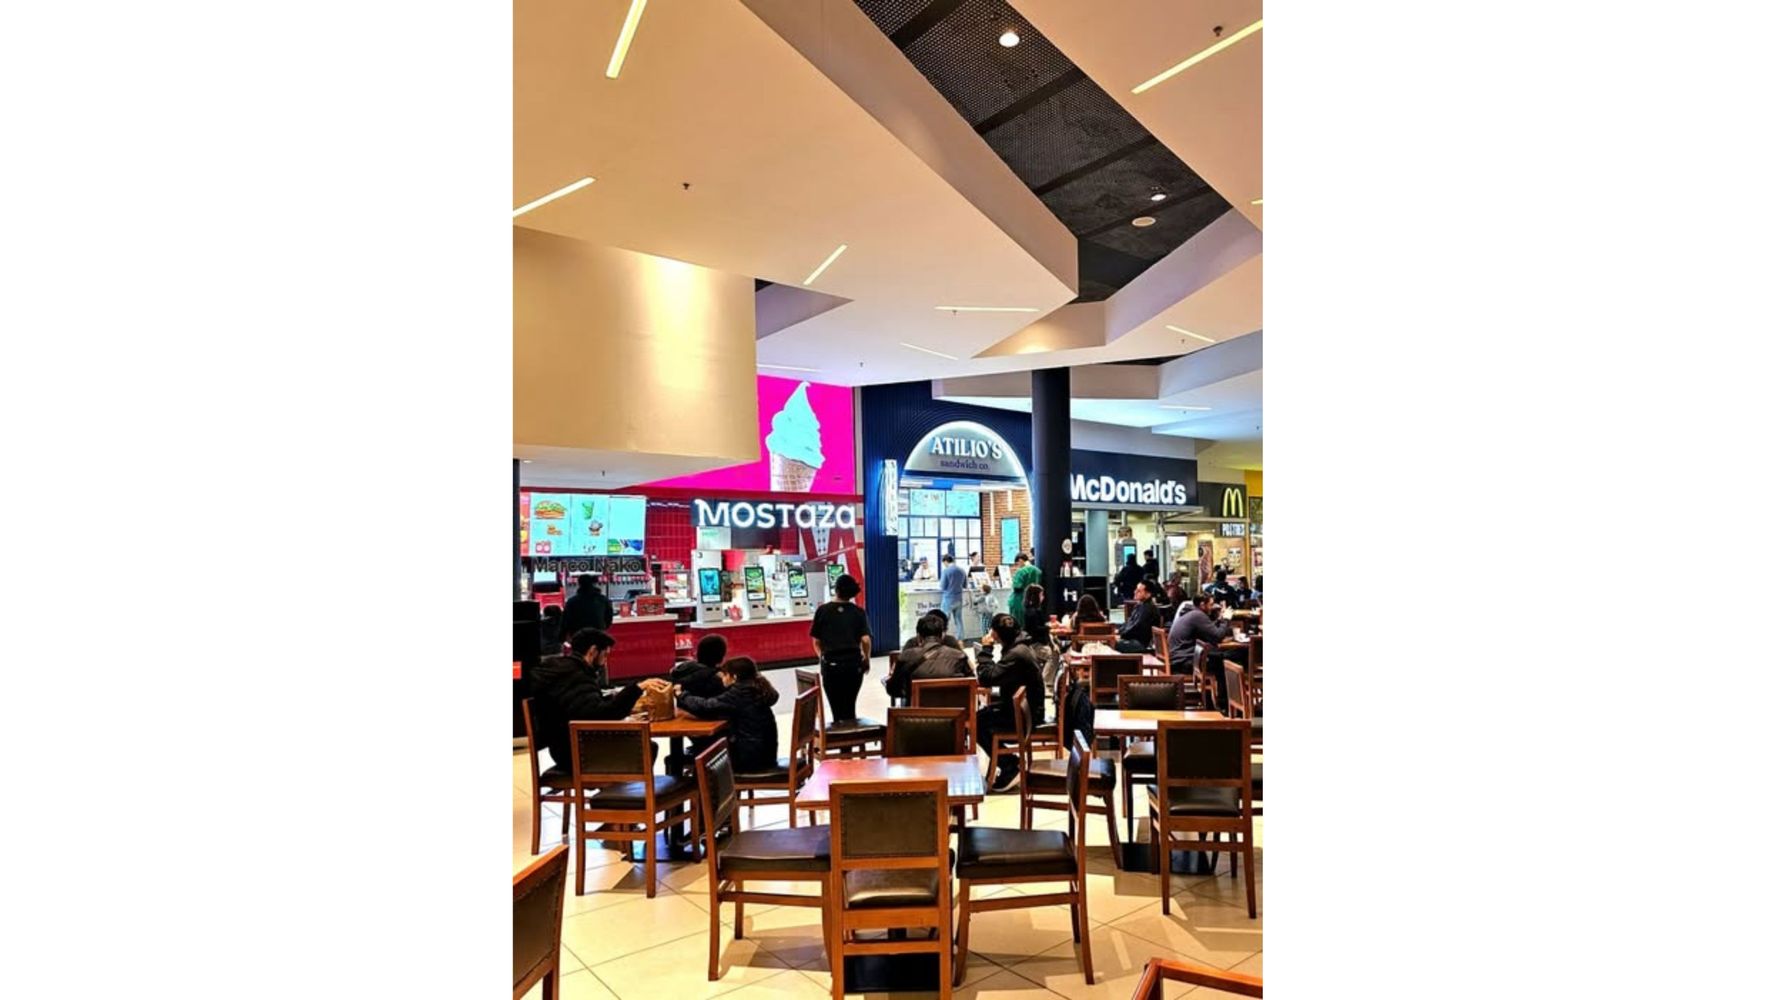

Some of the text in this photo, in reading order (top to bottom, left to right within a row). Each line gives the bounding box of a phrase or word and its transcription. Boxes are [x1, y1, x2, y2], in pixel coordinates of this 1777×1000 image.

[932, 437, 1002, 459] ATILIO'S
[941, 460, 977, 469] sandwich
[1070, 474, 1187, 504] McDonald's
